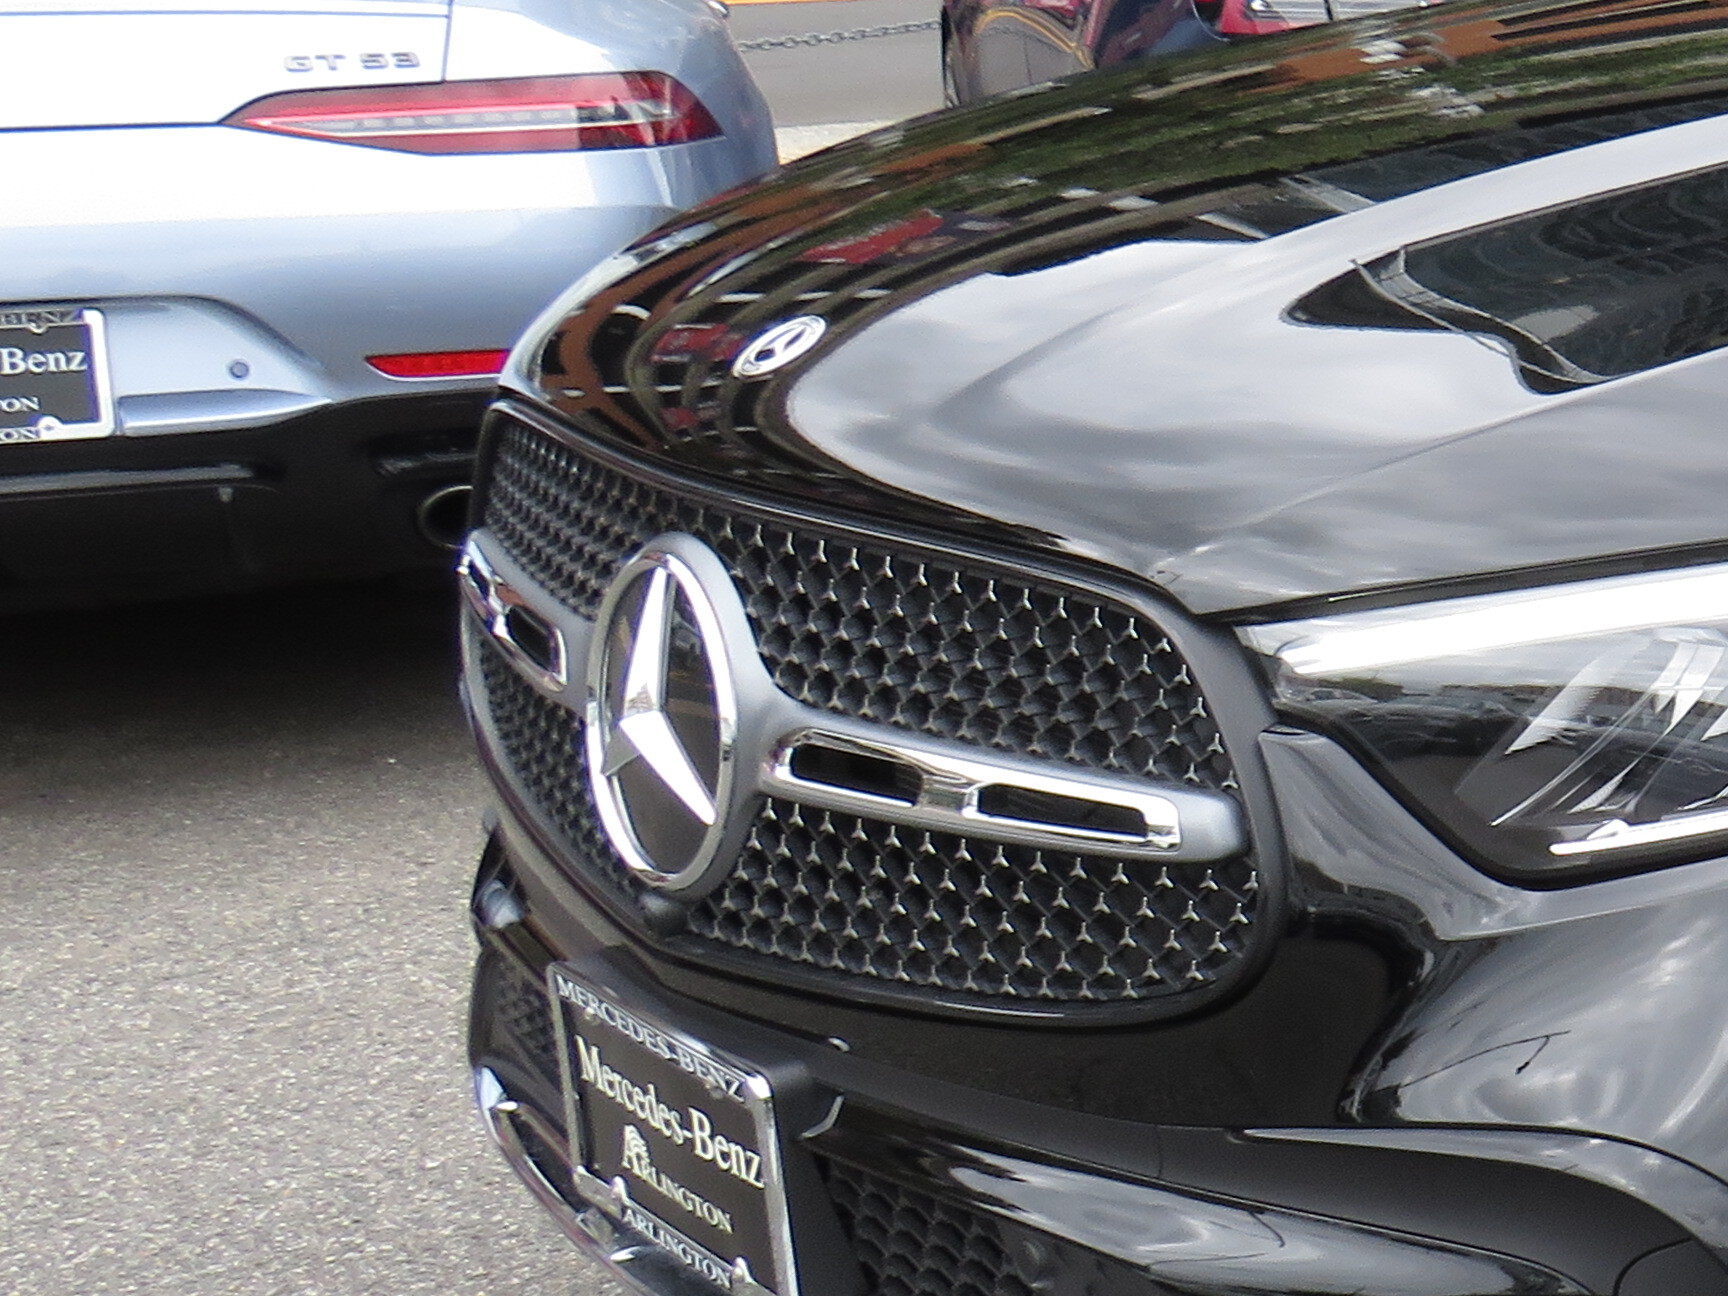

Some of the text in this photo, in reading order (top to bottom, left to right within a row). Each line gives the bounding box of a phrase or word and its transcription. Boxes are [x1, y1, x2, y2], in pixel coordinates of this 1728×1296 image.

[284, 51, 421, 73] GT 53
[556, 974, 747, 1103] MERCEDES-BENZ
[575, 1034, 765, 1190] Mercedes-Benz
[622, 1208, 732, 1289] ARLINGTON
